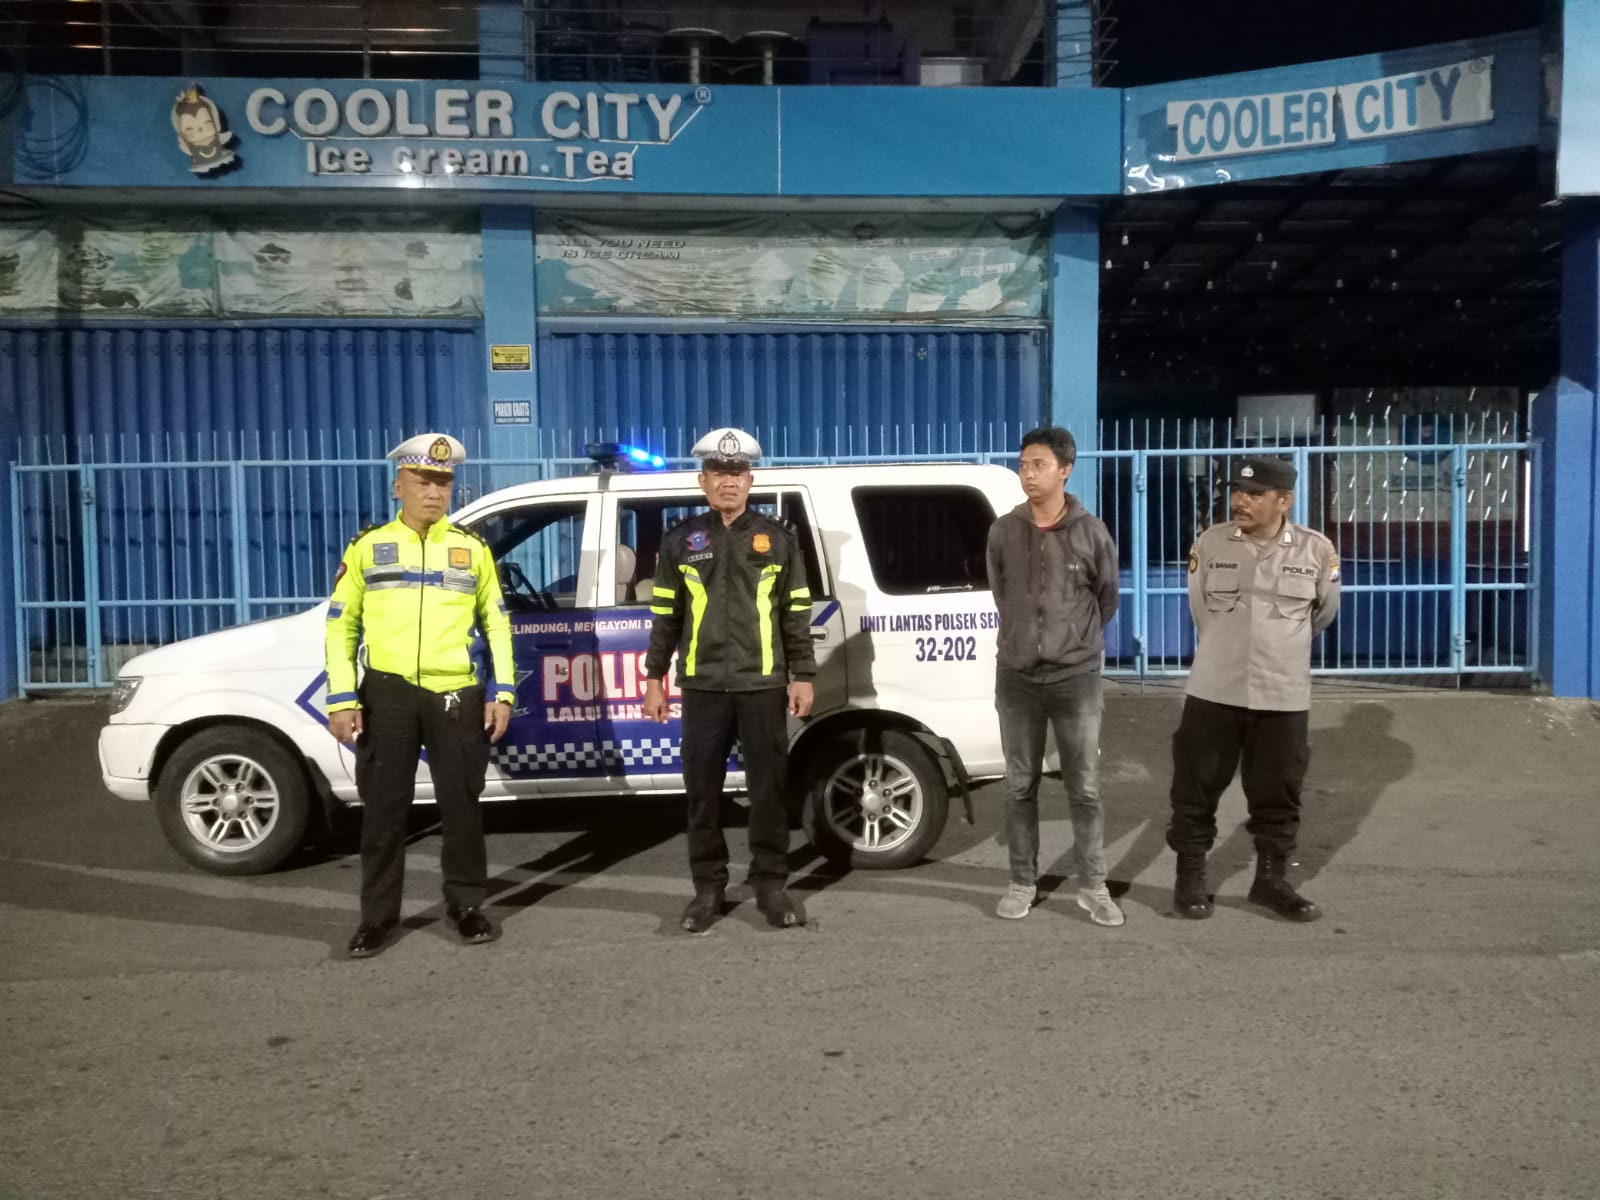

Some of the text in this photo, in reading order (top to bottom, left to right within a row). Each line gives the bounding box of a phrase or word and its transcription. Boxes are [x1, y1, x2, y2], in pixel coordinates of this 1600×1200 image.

[246, 88, 514, 138] COOLER
[541, 91, 682, 141] CITY
[1182, 90, 1328, 155] COOLER
[1355, 67, 1460, 133] CITY
[307, 141, 372, 174] Ice
[555, 146, 634, 178] Tea
[557, 239, 686, 249] ALL YOU NEED
[561, 249, 681, 260] IS ICE CREAM
[1282, 565, 1315, 577] POLRI
[574, 619, 641, 633] MENGAYOMI
[860, 611, 1000, 633] UNIT LANTAS POLSEK SEN
[915, 636, 977, 662] 32-202
[547, 703, 682, 723] LALU LINS
